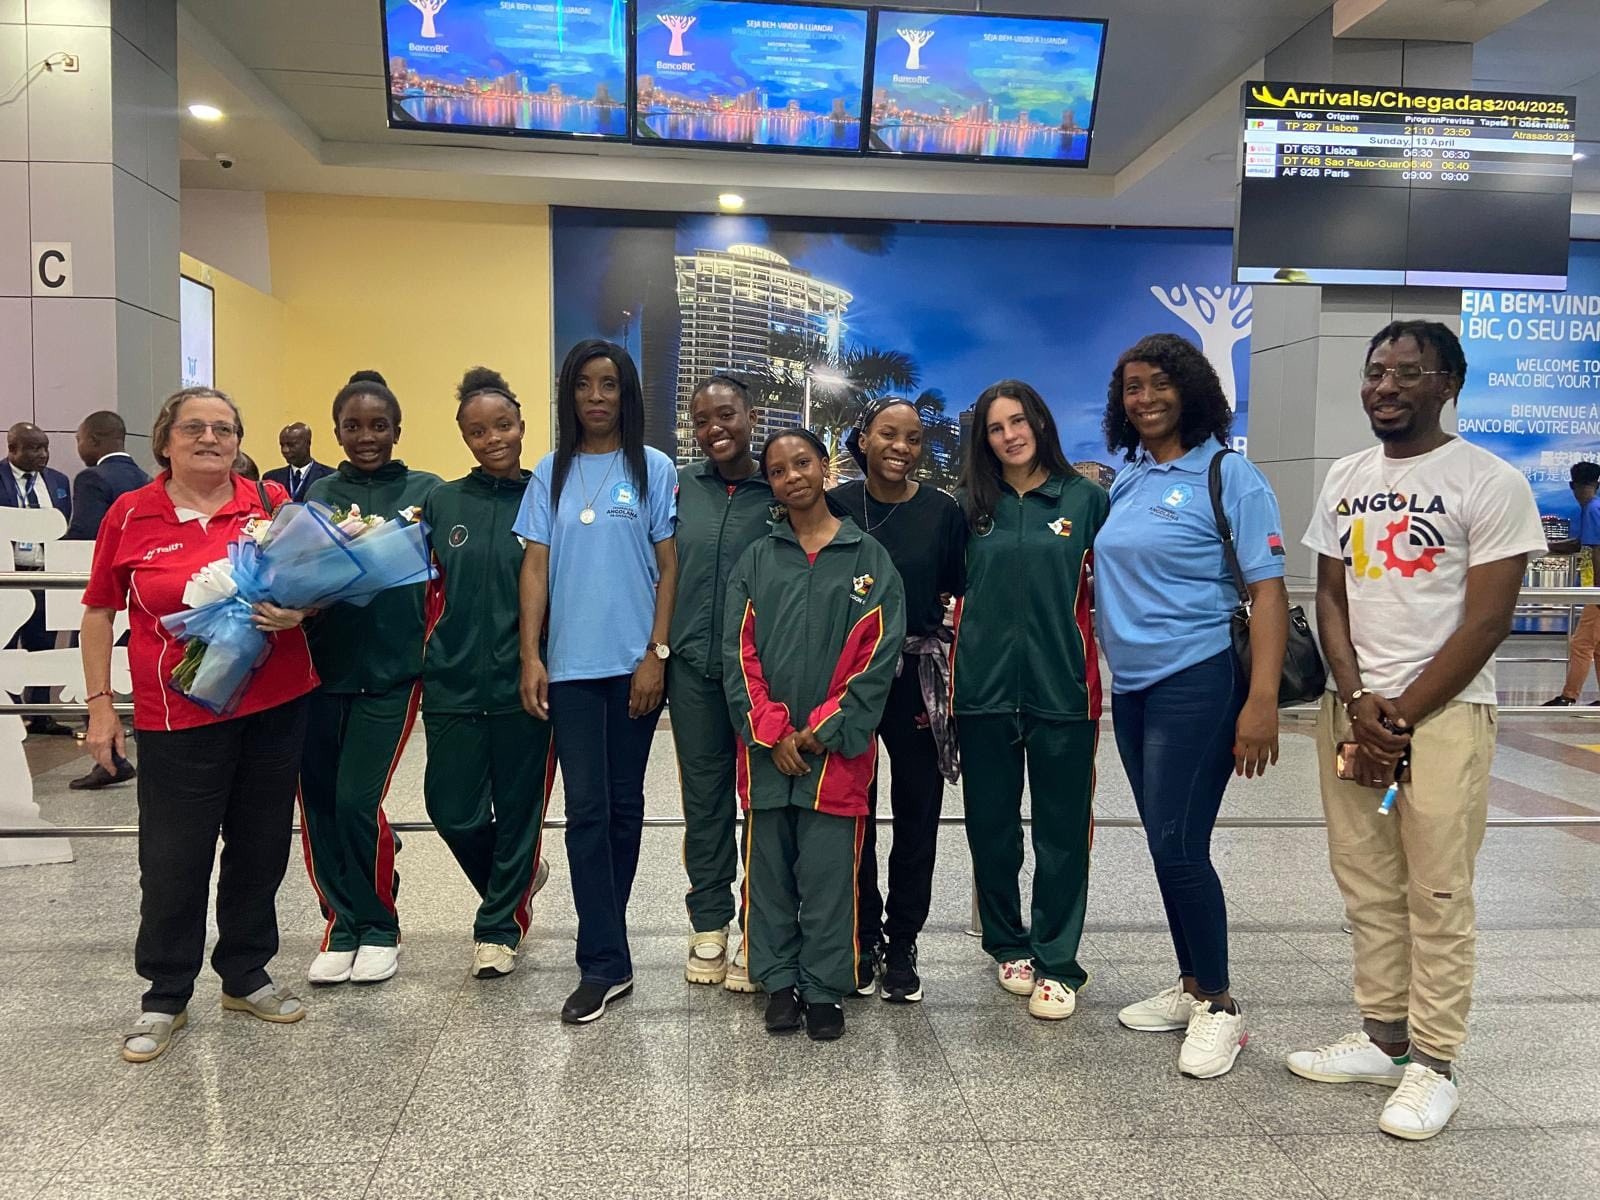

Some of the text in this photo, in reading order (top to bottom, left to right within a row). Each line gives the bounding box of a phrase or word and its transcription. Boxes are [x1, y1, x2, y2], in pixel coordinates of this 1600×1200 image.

[656, 60, 696, 72] BancoBIC
[1283, 86, 1495, 113] Arrivals/Chegadas
[1494, 98, 1569, 116] 2/04/2025,
[1295, 111, 1313, 119] Voo
[1326, 112, 1359, 122] Origem
[1441, 116, 1475, 125] Prevista
[1285, 121, 1300, 131] TP
[1302, 122, 1322, 132] 287
[1326, 123, 1358, 133] Lisboa
[1403, 126, 1434, 135] 21:10
[1443, 127, 1471, 137] 23:50
[1512, 130, 1554, 140] Atrasado
[1283, 144, 1299, 154] DT
[1301, 145, 1321, 155] 653
[1325, 146, 1358, 156] Lisboa
[1416, 137, 1428, 146] 13
[1431, 138, 1455, 148] April
[1283, 156, 1299, 165] DT
[1301, 157, 1321, 167] 748
[1325, 158, 1345, 167] Sao
[1282, 168, 1469, 182] AF 928 Paris 09:00 09:00
[38, 249, 66, 289] C
[1461, 291, 1496, 316] EJA
[1468, 318, 1504, 341] BIC,
[1507, 319, 1523, 340] O
[1526, 319, 1565, 341] SEU
[1516, 358, 1600, 373] WELCOME TO
[1488, 372, 1532, 388] BANCO
[1557, 374, 1591, 389] YOUR
[1511, 402, 1599, 419] BIENVENUE À
[1458, 418, 1501, 434] BANCO
[1527, 419, 1569, 434] VOTRE
[1336, 492, 1446, 516] ANGOLA
